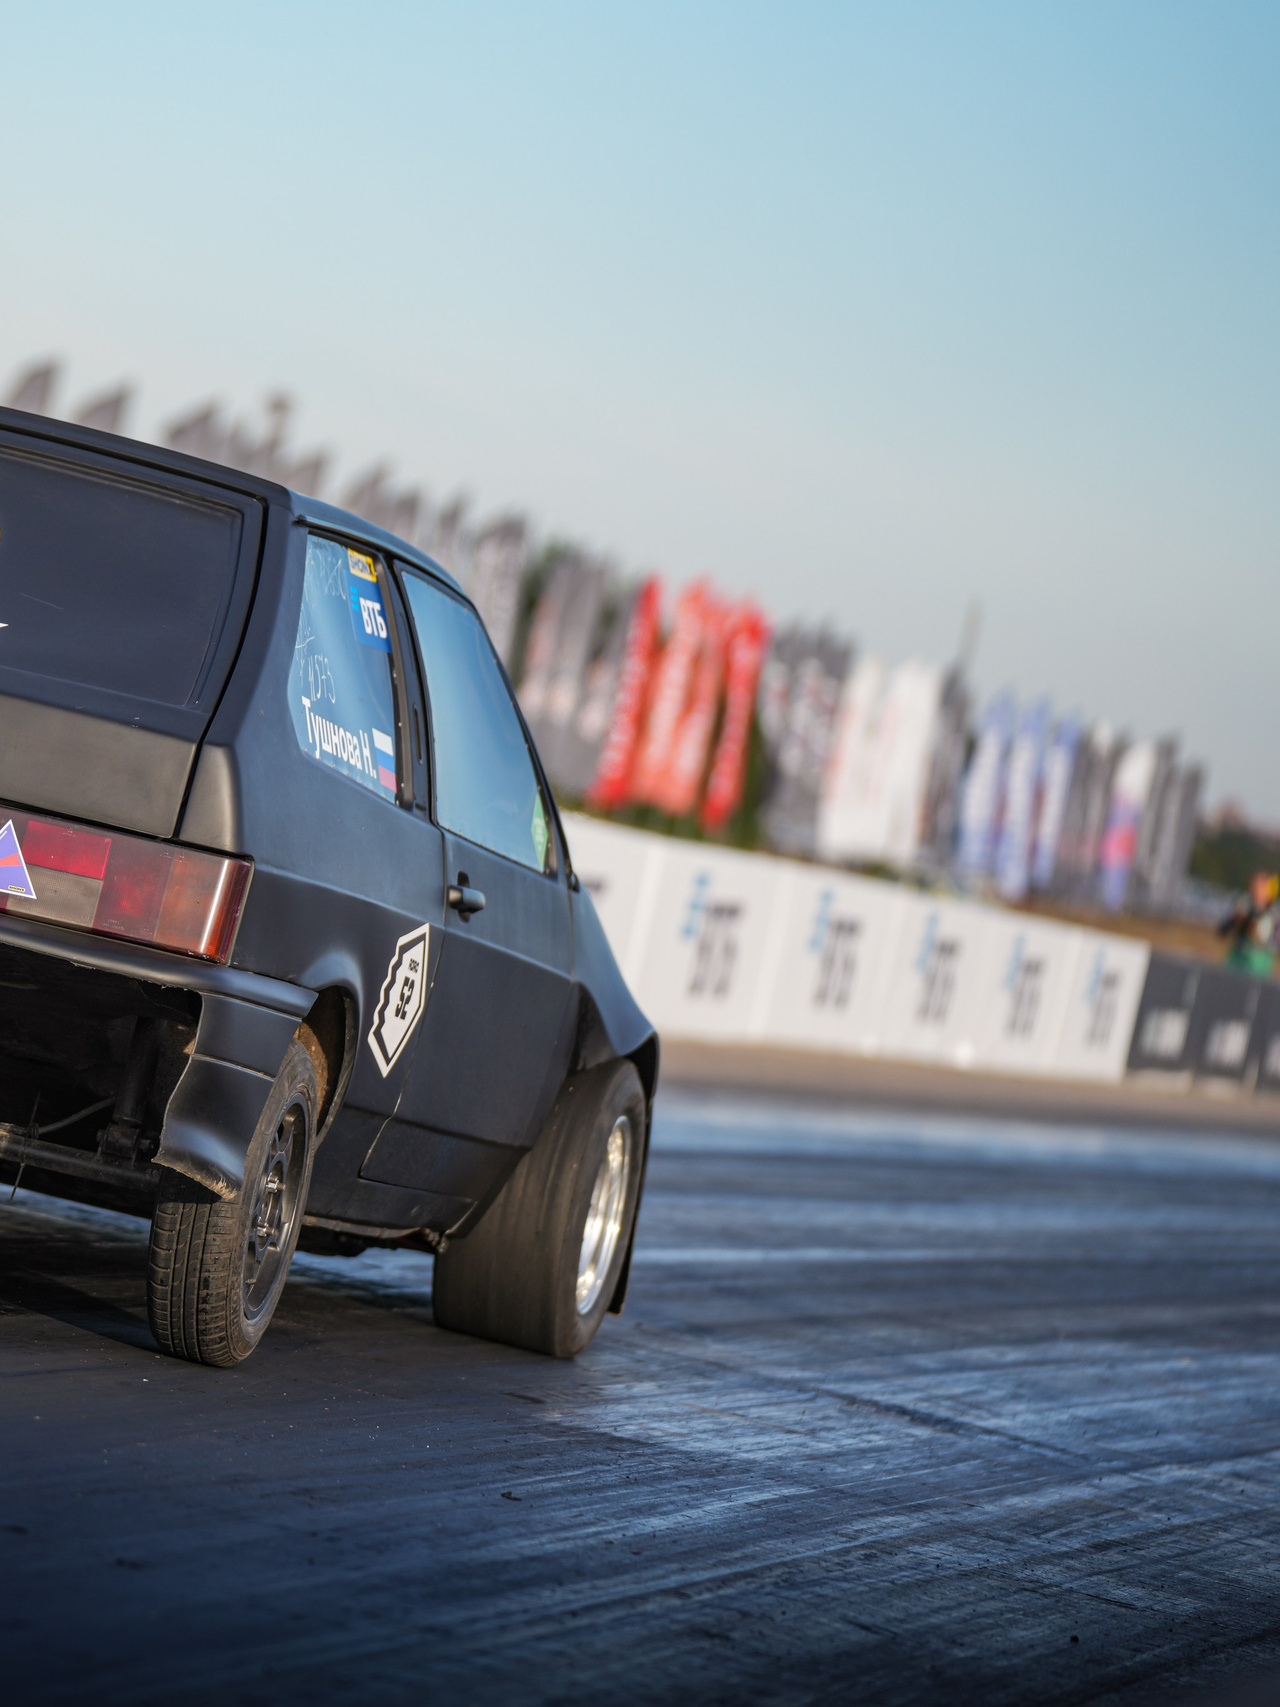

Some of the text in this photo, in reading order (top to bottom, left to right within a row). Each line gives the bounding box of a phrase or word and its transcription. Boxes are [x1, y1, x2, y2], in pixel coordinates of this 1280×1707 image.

[359, 596, 387, 639] ВТБ
[302, 695, 377, 779] Тушнова Н.
[395, 976, 415, 1020] 52
